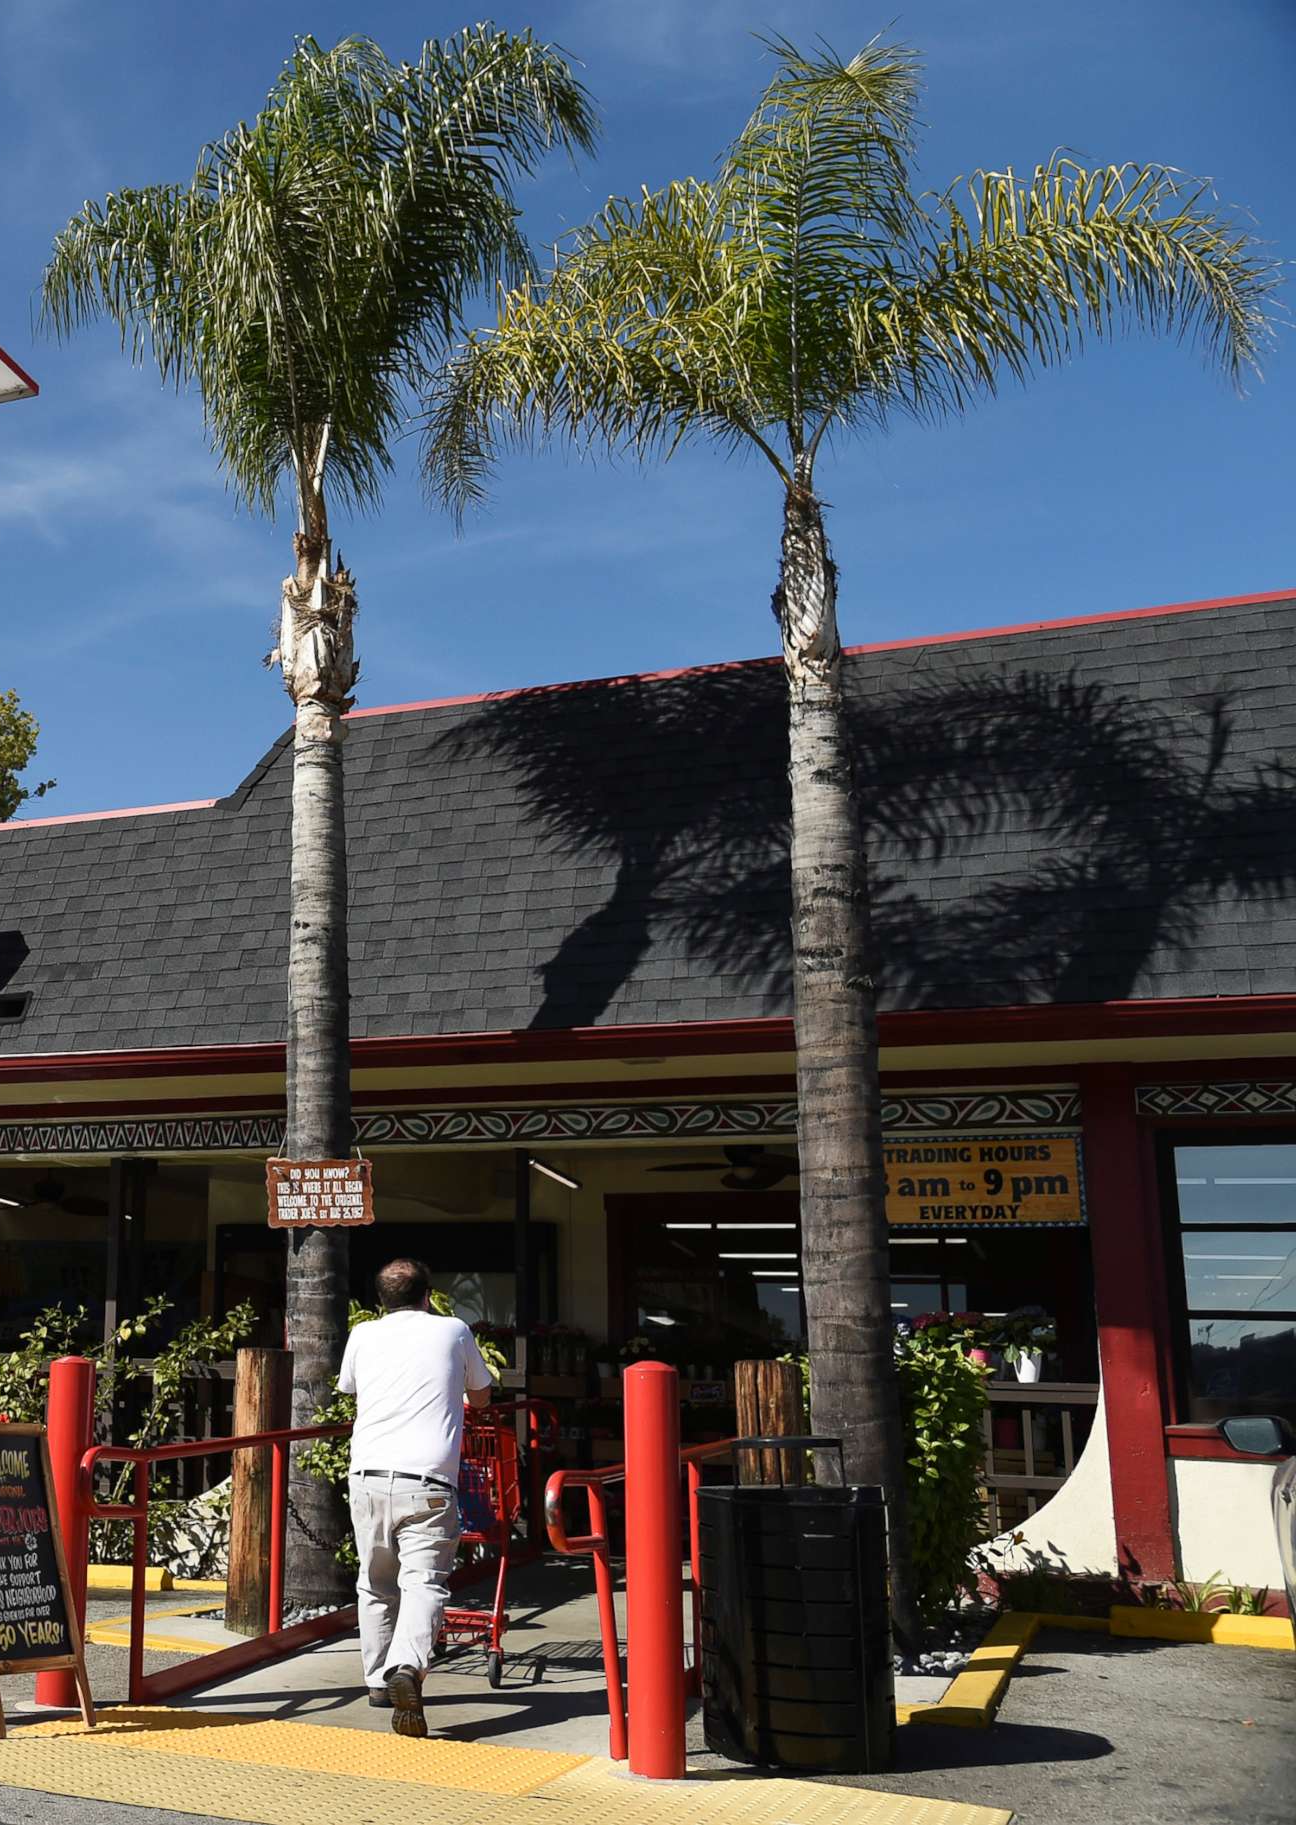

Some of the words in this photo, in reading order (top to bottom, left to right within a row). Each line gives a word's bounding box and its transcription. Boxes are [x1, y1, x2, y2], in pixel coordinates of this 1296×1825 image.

[885, 1147, 972, 1163] TRADING
[980, 1145, 1052, 1162] HOURS
[290, 1168, 302, 1179] DID
[304, 1168, 320, 1179] YOU
[323, 1167, 350, 1179] KNOW?
[277, 1182, 290, 1194] THIS
[302, 1181, 322, 1193] WHERE
[324, 1181, 330, 1193] IT
[332, 1181, 343, 1193] ALL
[898, 1177, 950, 1197] am
[959, 1179, 976, 1191] to
[984, 1169, 1003, 1195] 9
[1011, 1173, 1069, 1202] pm
[277, 1195, 308, 1207] WELCOME
[310, 1195, 319, 1206] TO
[321, 1195, 333, 1206] THE
[335, 1194, 363, 1206] ORIGINAL
[278, 1208, 299, 1220] TRADER
[919, 1205, 1022, 1220] EVERYDAY
[8, 1555, 23, 1571] YOU
[24, 1552, 38, 1569] FOR
[9, 1570, 41, 1586] SUPPORT
[5, 1585, 56, 1608] NEIGHBORHOOD
[25, 1607, 35, 1618] FOR
[36, 1605, 50, 1616] OVER
[17, 1620, 64, 1648] YEARS!
